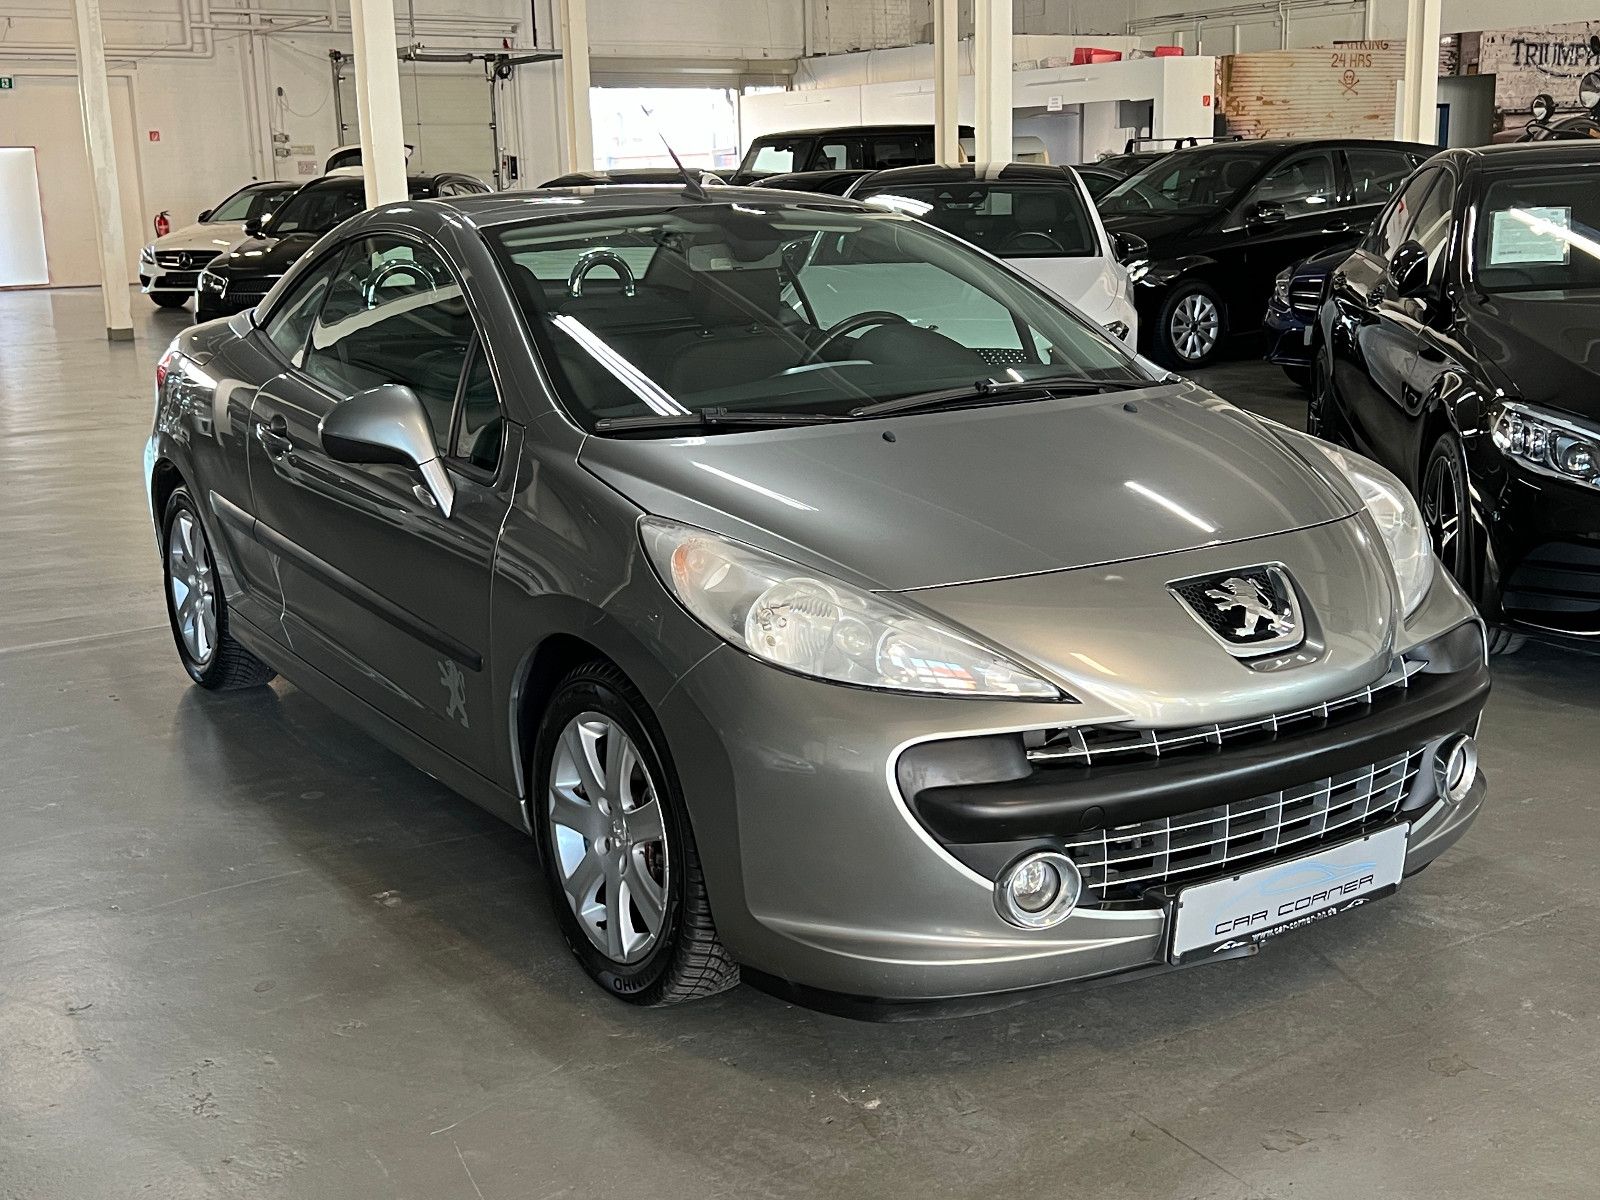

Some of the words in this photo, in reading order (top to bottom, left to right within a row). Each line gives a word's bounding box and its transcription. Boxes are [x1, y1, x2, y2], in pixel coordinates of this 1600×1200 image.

[1331, 53, 1346, 68] 24
[1350, 53, 1372, 68] HRS
[1214, 910, 1268, 936] CAR
[1277, 874, 1374, 917] CORNER
